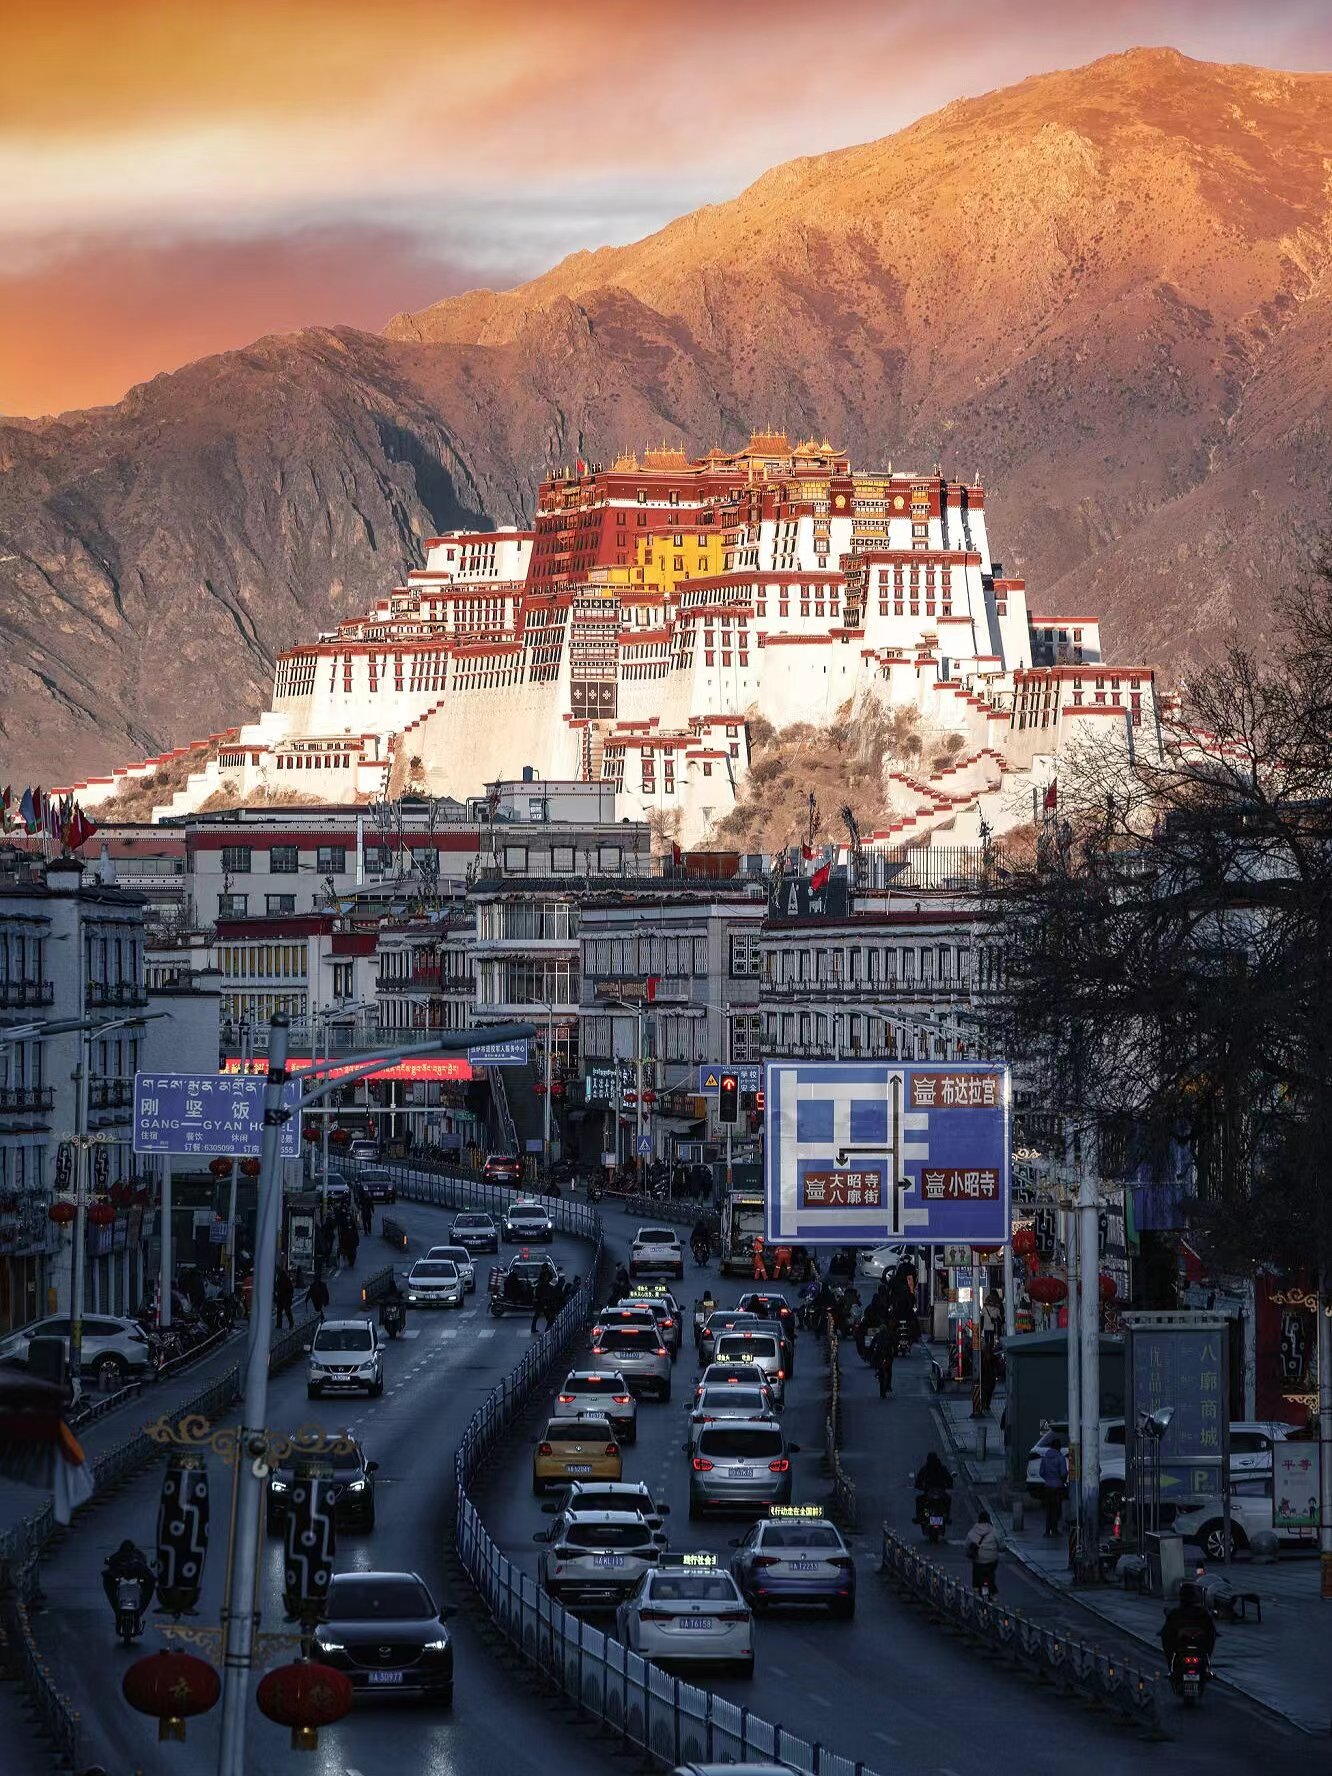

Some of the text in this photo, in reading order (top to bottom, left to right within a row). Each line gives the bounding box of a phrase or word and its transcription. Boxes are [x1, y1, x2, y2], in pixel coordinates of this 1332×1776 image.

[941, 1076, 996, 1105] 布达拉宫
[249, 1122, 294, 1132] HOEL
[829, 1173, 880, 1189] 大昭寺
[948, 1171, 996, 1198] 小昭寺
[829, 1189, 879, 1204] 八廓街
[1200, 1344, 1218, 1447] 八廓商城
[1195, 1471, 1208, 1491] P
